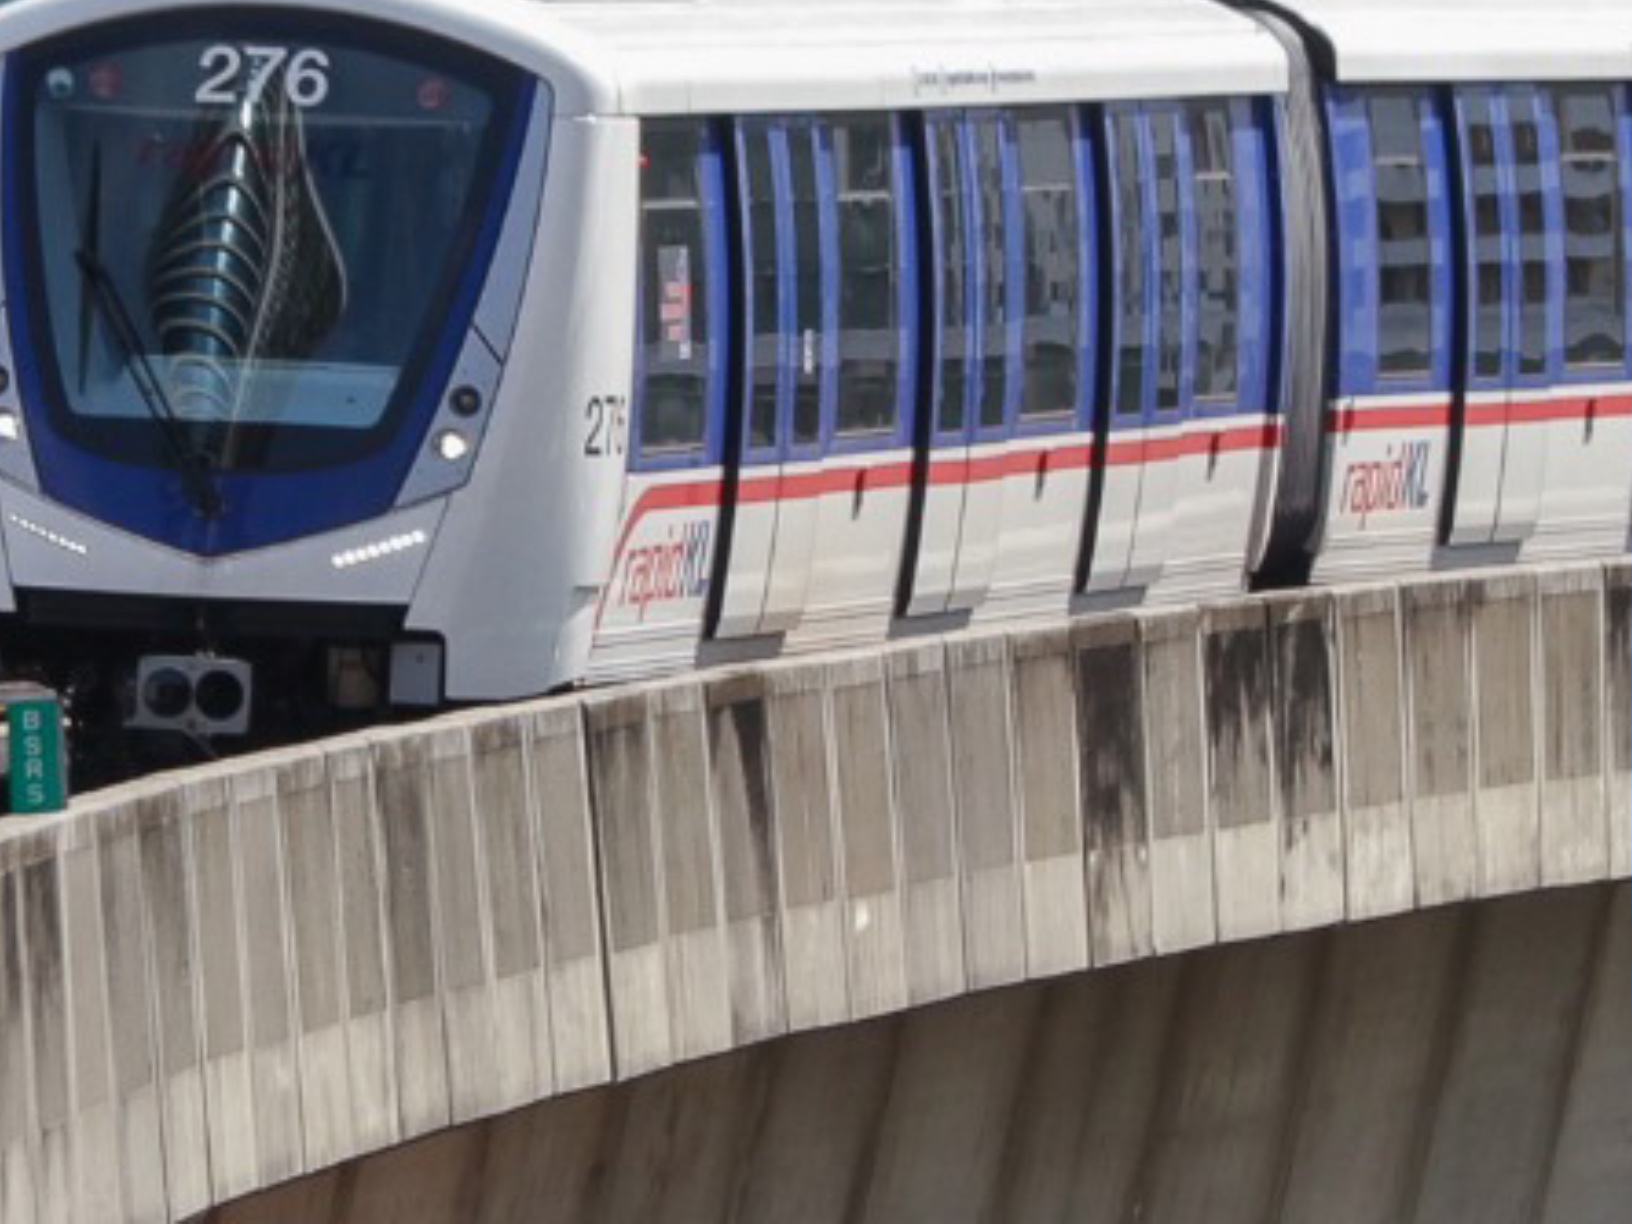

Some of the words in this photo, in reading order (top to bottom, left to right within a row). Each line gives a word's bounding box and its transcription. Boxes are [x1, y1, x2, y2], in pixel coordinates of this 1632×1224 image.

[195, 45, 329, 107] 276
[1340, 439, 1430, 531] rapidKL
[618, 520, 710, 623] rapidKL
